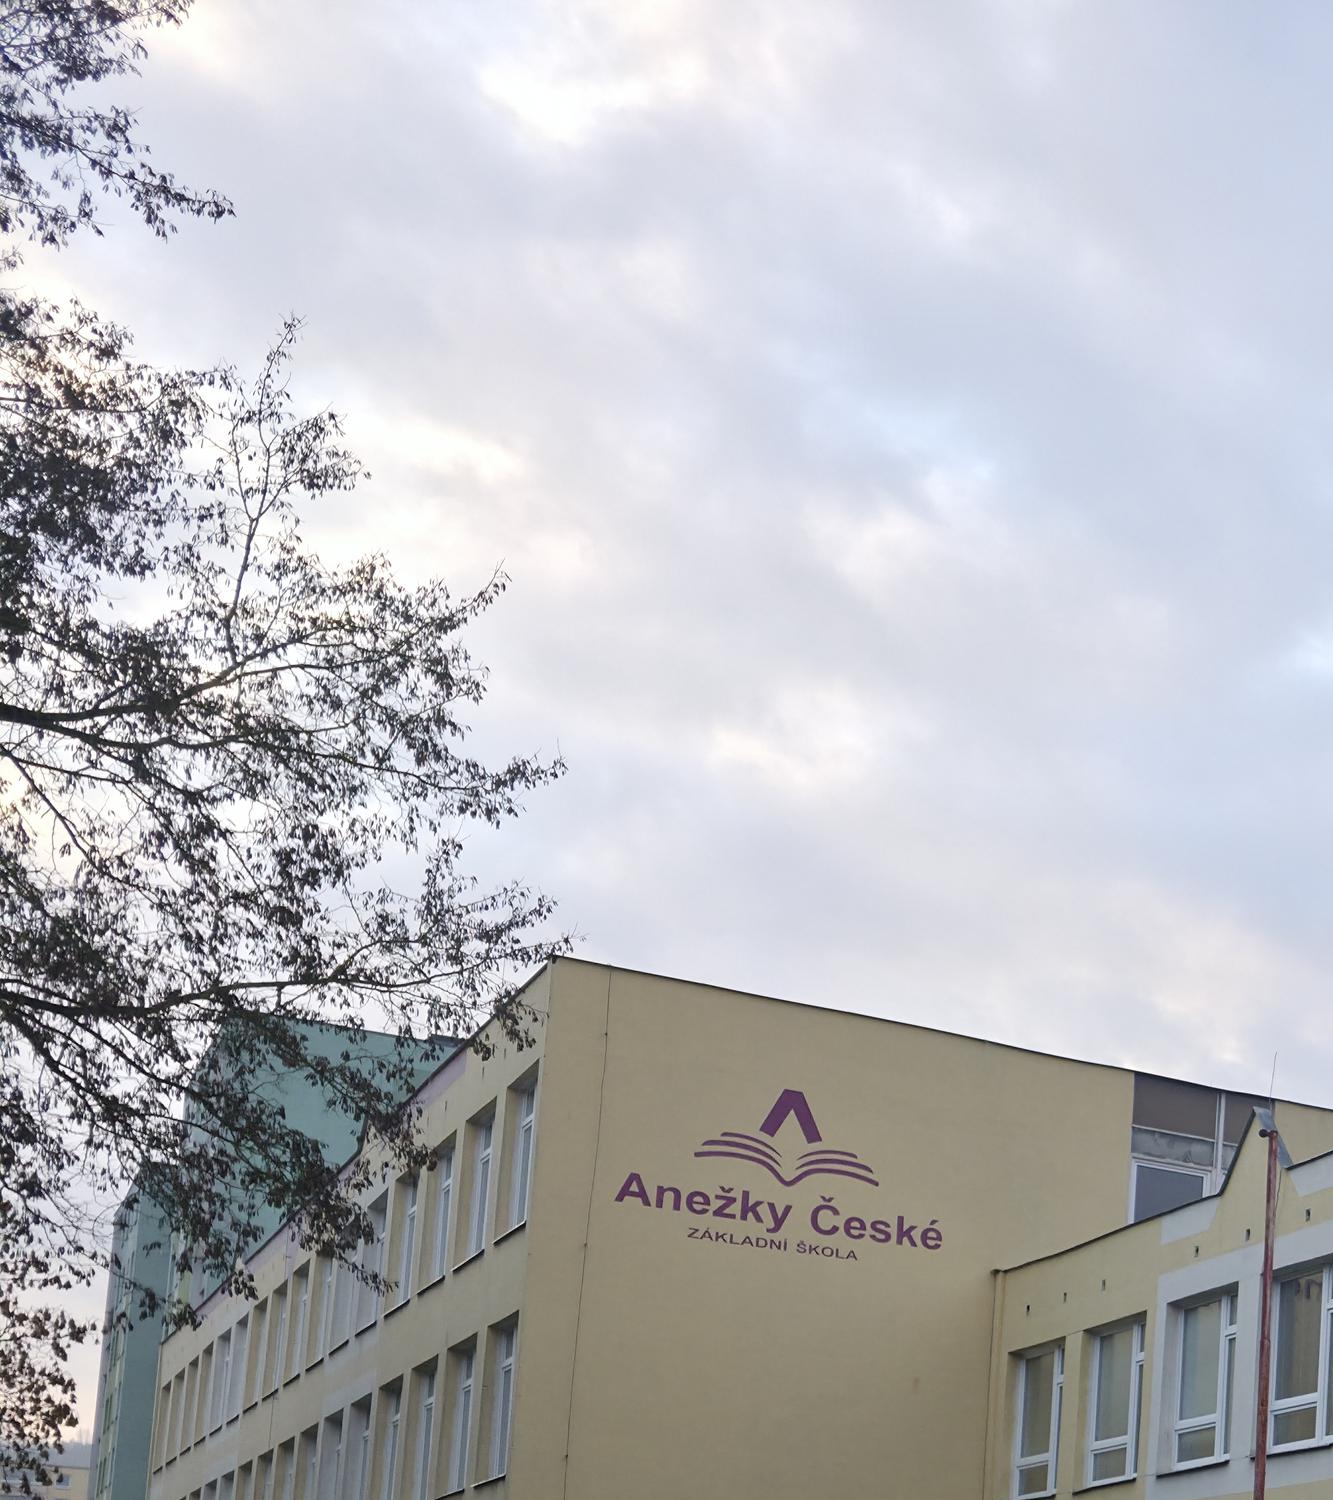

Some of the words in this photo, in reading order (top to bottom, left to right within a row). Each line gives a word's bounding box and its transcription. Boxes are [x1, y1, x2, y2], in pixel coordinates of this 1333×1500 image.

[614, 1171, 793, 1234] Anežky
[810, 1195, 943, 1250] České
[687, 1226, 788, 1252] ZÁKLADNÍ
[796, 1240, 858, 1261] ŠKOLA
